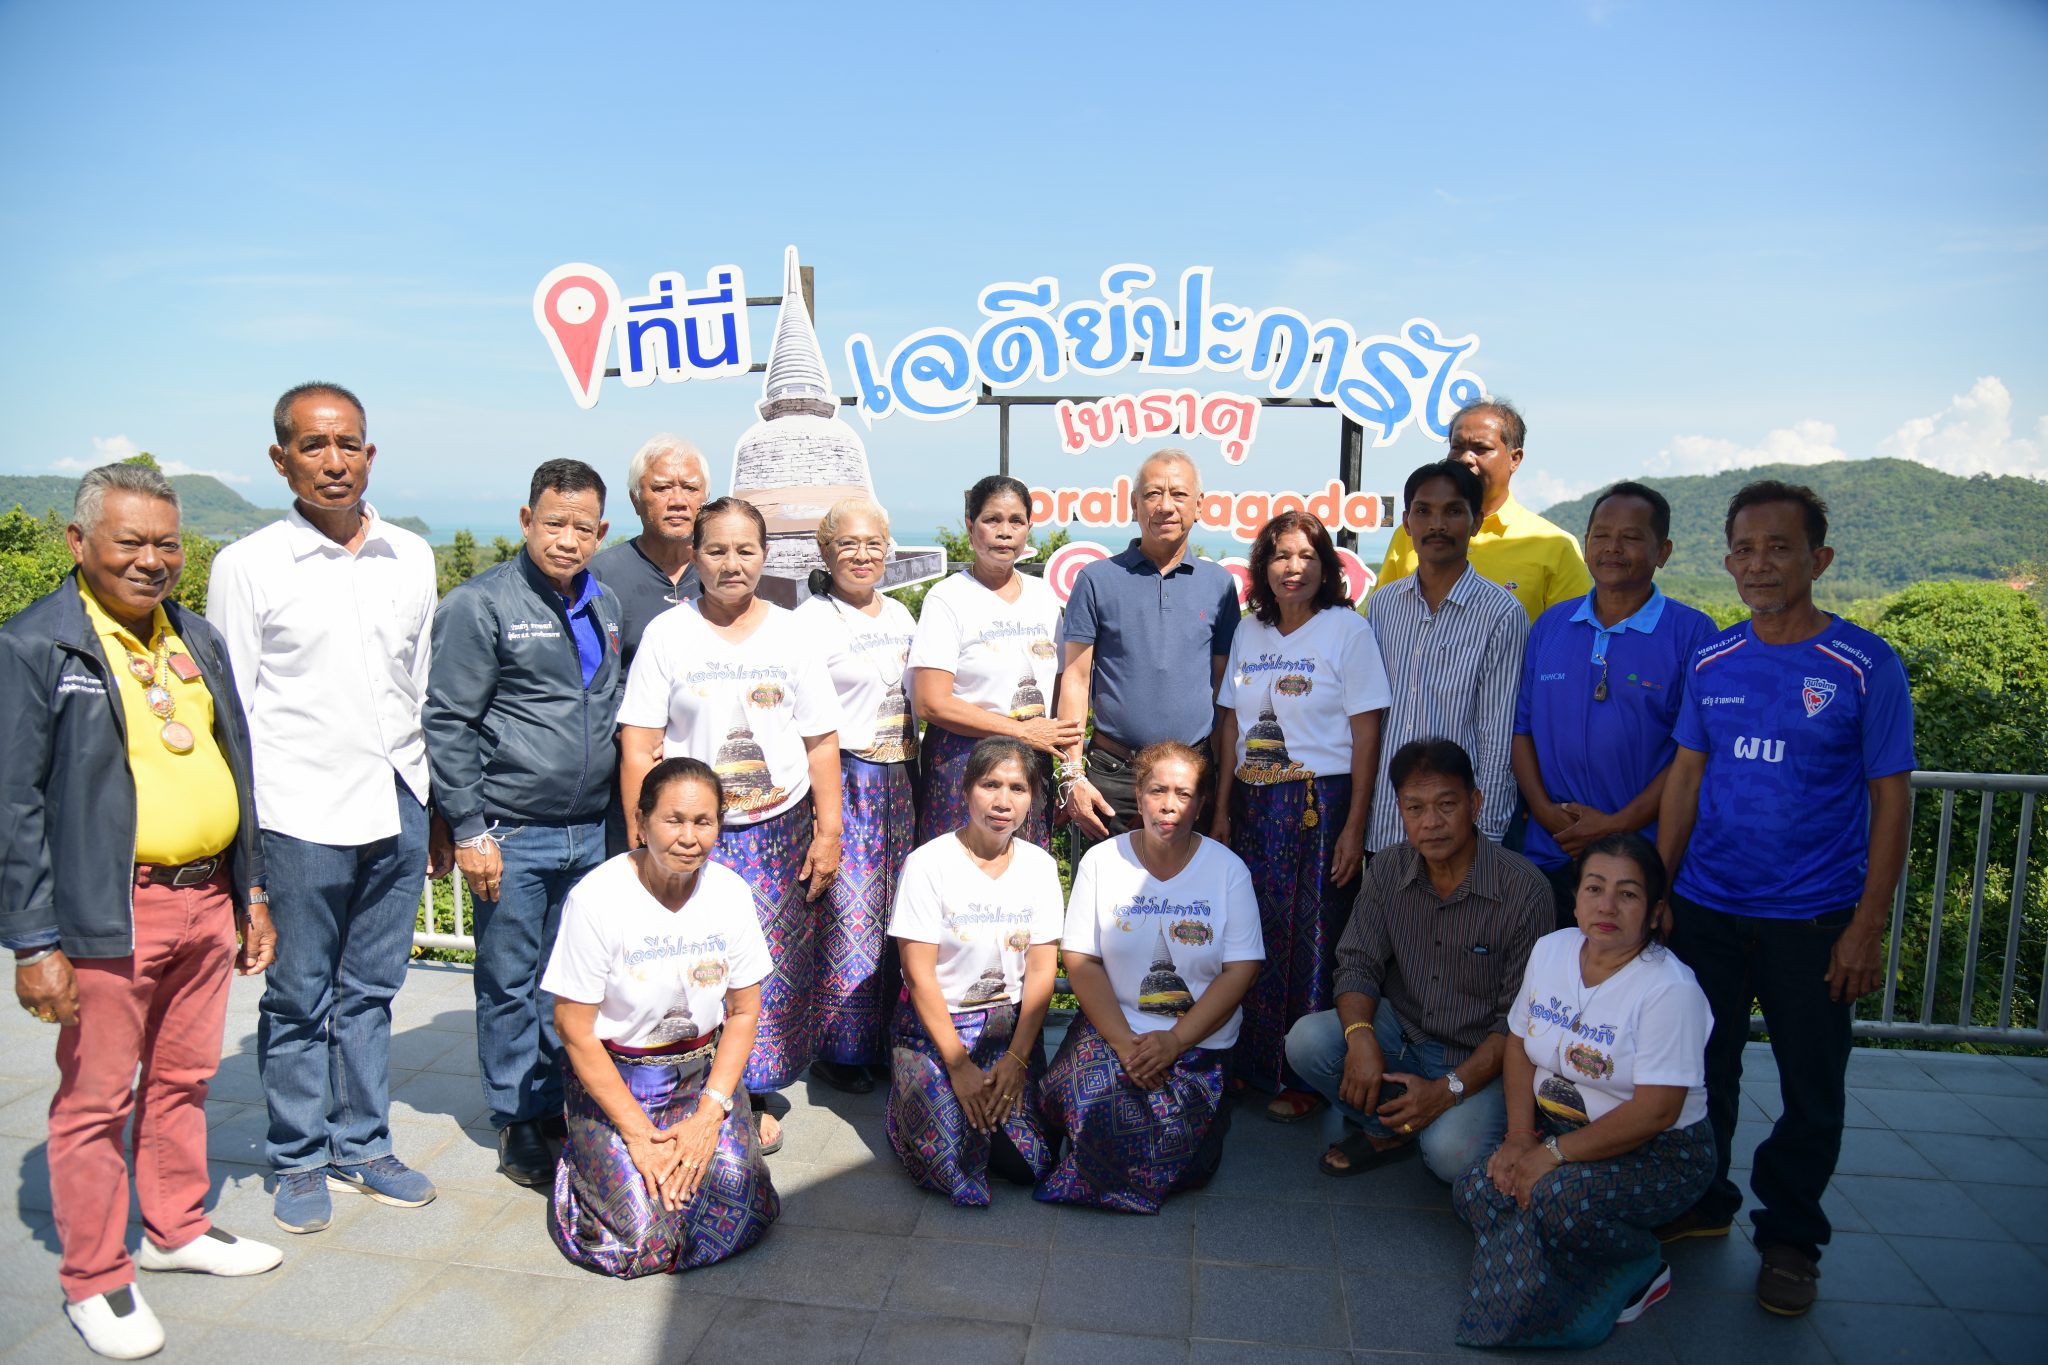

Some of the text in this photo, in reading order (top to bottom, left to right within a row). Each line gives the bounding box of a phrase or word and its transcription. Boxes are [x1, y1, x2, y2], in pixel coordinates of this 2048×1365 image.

[627, 273, 738, 373] ที่นี่
[852, 270, 1483, 438] เจดีย์ปะการัง
[1061, 393, 1257, 461] เขาธาตุ
[1029, 479, 1129, 523] oral
[686, 660, 788, 684] เจดีย์ปะการัง
[1242, 653, 1316, 674] เจดีย์ปะการัง
[1113, 895, 1211, 917] เจดีย์ปะการัง
[624, 933, 727, 966] เจดีย์ปะการัง
[1529, 995, 1618, 1046] เจดีย์ปการัง
